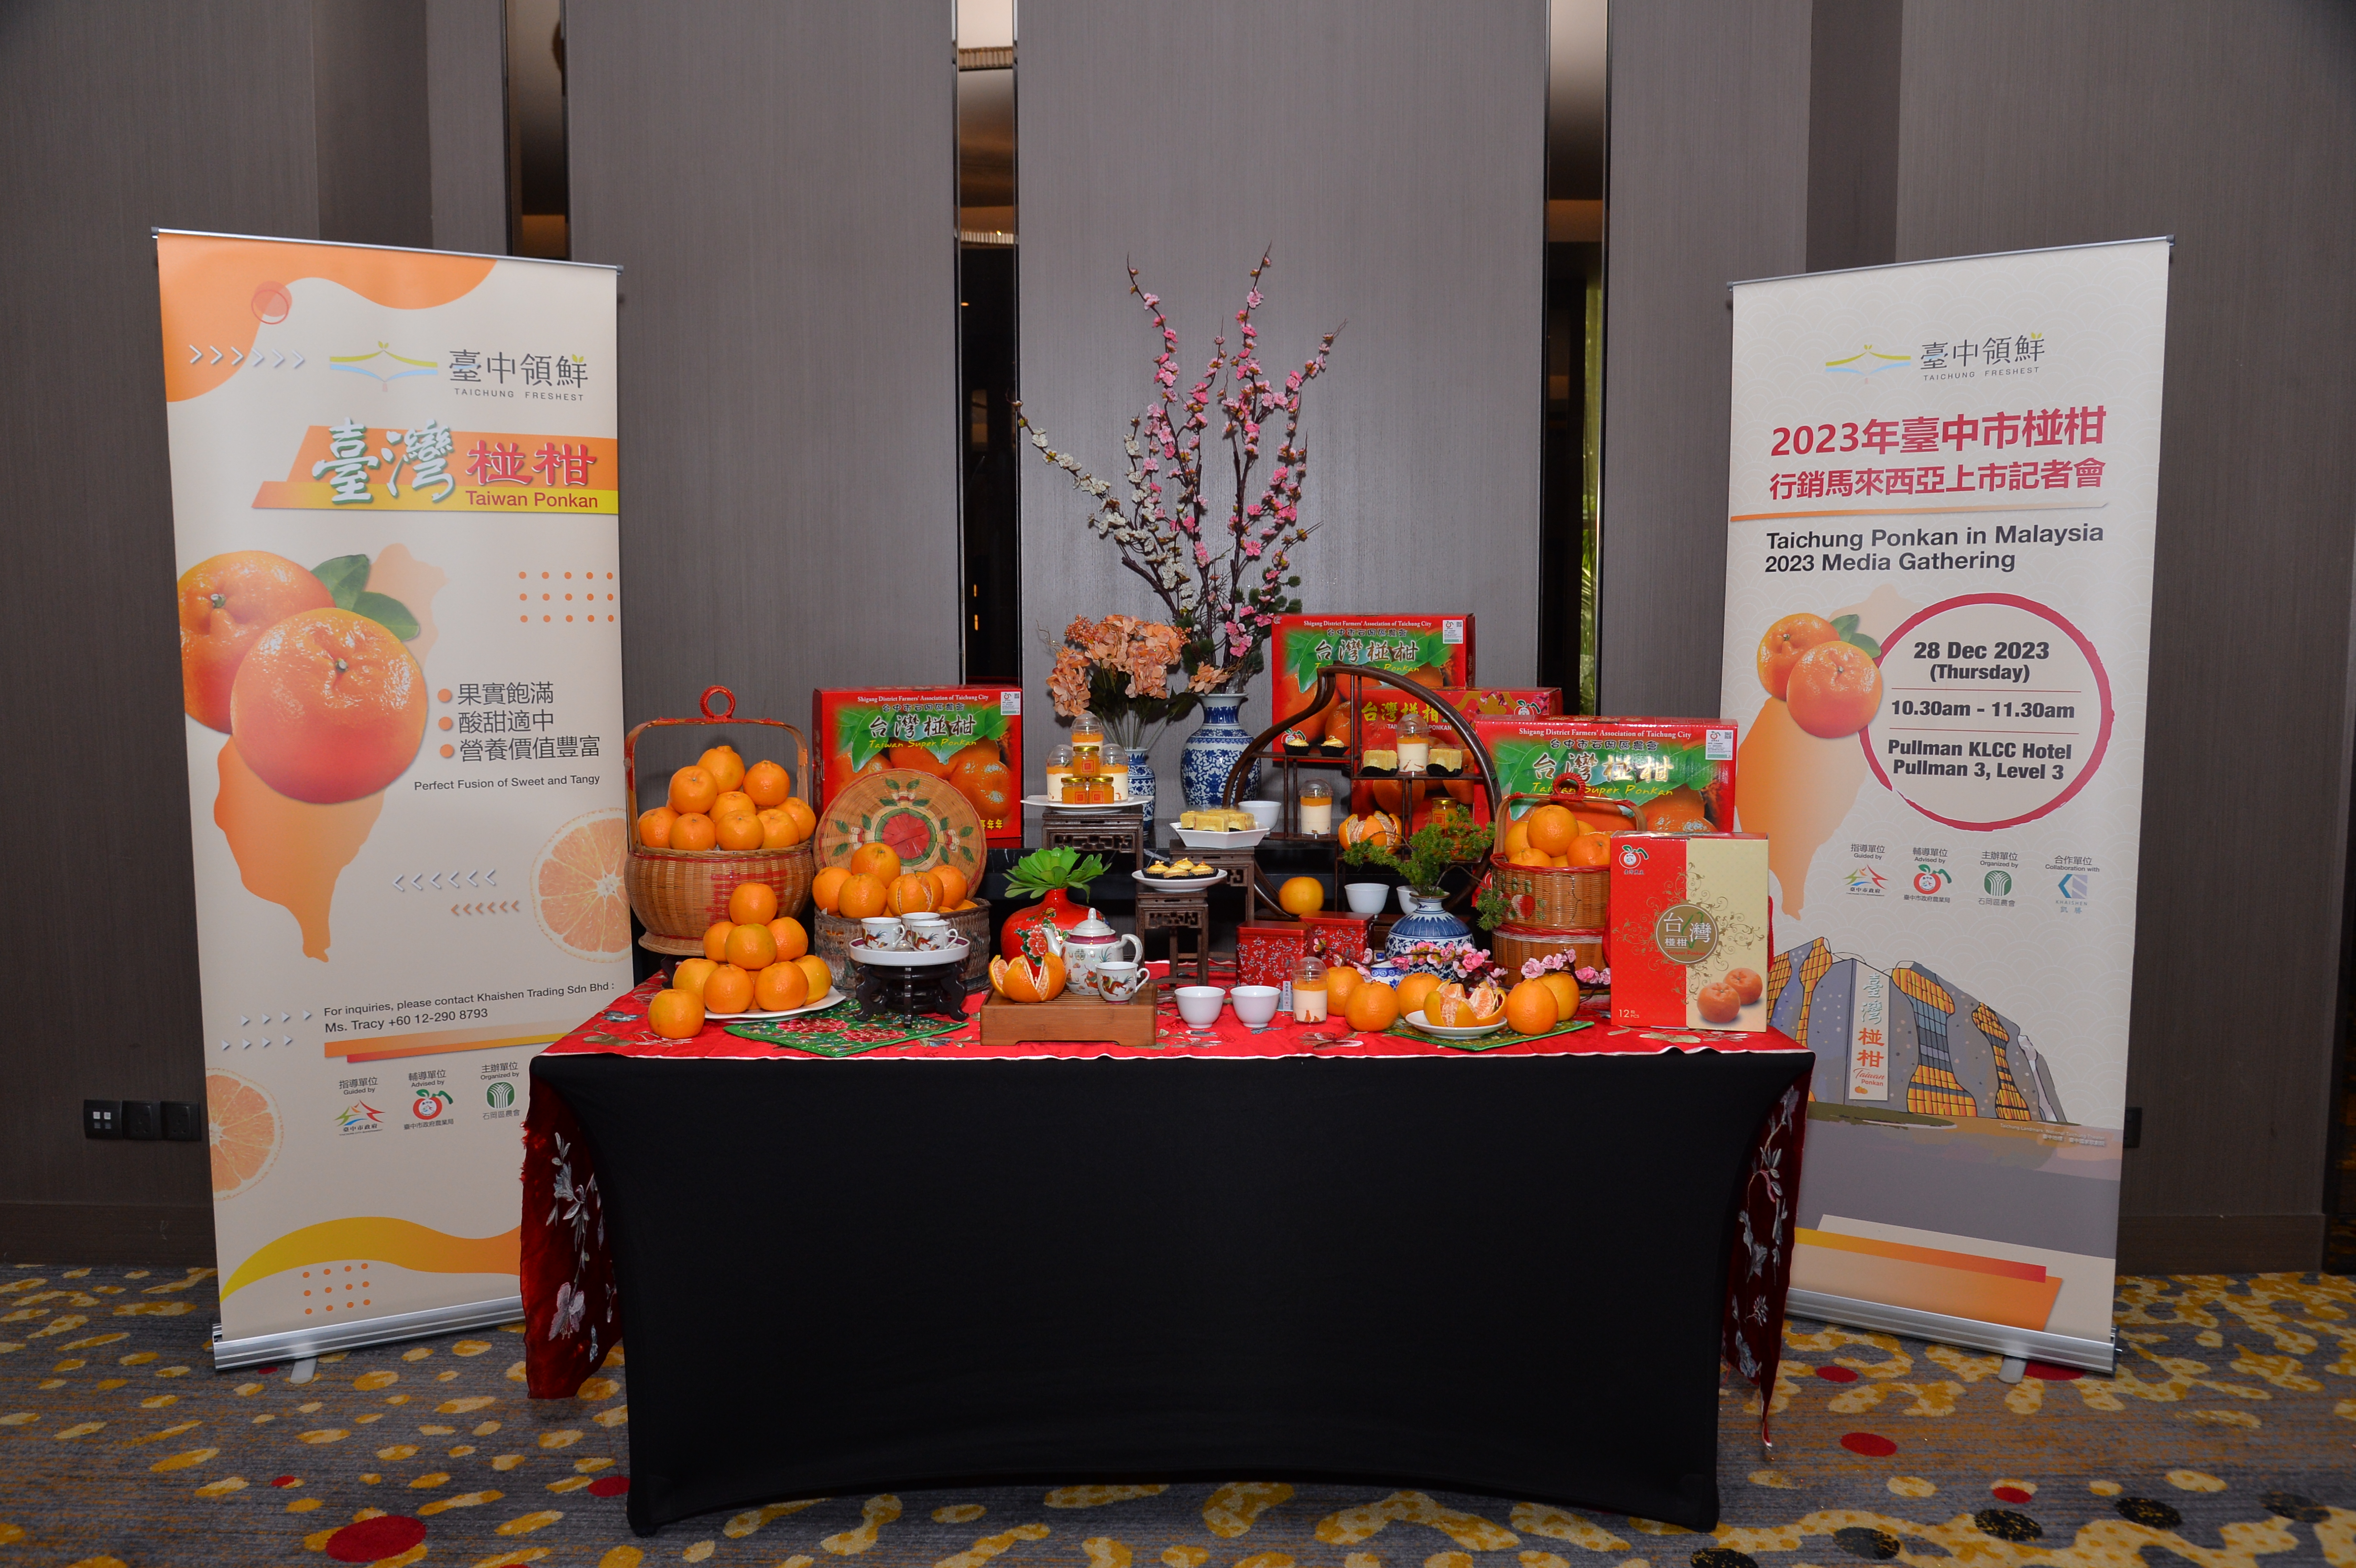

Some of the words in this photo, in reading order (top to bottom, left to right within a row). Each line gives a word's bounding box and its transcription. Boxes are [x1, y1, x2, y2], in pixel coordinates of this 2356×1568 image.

[1920, 334, 2045, 370] 臺中領鮮
[449, 348, 589, 388] 臺中領鮮
[1924, 372, 1975, 381] TAICHUNG
[1985, 367, 2039, 376] FRESHEST
[455, 388, 514, 398] TAICHUNG
[525, 391, 584, 402] FRESHEST
[1770, 405, 2106, 457] 2023年臺中市椪柑
[1770, 457, 2105, 501] 行銷馬來西亞上市記者會
[466, 490, 527, 506] Taiwan
[534, 492, 598, 508] Ponkan
[1767, 532, 1864, 551] Taichung
[1872, 529, 1958, 547] Ponkan
[1966, 528, 1986, 544] in
[1996, 523, 2104, 548] Malaysia
[1766, 555, 1814, 573] 2023
[1822, 554, 1891, 571] Media
[1899, 551, 2016, 572] Gathering
[1315, 639, 1419, 663] 台灣椪柑
[1914, 642, 1940, 659] 28
[1948, 642, 1987, 659] Dec
[1994, 642, 2049, 659] 2023
[1384, 664, 1419, 672] Ponkan
[1930, 664, 2030, 683] (Thursday)
[458, 681, 554, 706] 果實飽滿
[1892, 700, 1971, 716] 10.30am
[1992, 702, 2074, 719] 11.30am
[458, 709, 554, 734] 酸甜適中
[869, 714, 976, 739] 台灣椪柑
[1519, 728, 1544, 736] Shigang
[1646, 730, 1676, 739] Taichung
[1677, 731, 1691, 740] City
[460, 735, 600, 762] 營養價值豐富
[870, 740, 903, 748] Taiwan
[908, 740, 937, 749] Super
[1888, 740, 1962, 756] Pullman
[1969, 742, 2016, 758] KLCC
[2023, 743, 2072, 760] Hotel
[1533, 752, 1674, 783] 台灣椪柑
[1893, 760, 1967, 776] Pullman
[1974, 762, 1990, 780] 3,
[1997, 763, 2045, 779] Level
[2052, 765, 2063, 780] 3
[414, 781, 454, 790] Perfect
[458, 780, 494, 789] Fusion
[498, 779, 508, 787] of
[511, 777, 544, 787] Sweet
[548, 776, 567, 785] and
[570, 774, 600, 785] Tangy
[1532, 783, 1576, 793] Taian
[1625, 785, 1673, 795] Ponkan
[1851, 844, 1885, 853] 指導單位
[1913, 848, 1948, 857] 輔導單位
[1982, 851, 2018, 861] 主辦單位
[2054, 856, 2092, 865] 合作單位
[1904, 895, 1950, 903] 臺中市政府農業局
[1978, 898, 2015, 907] 石岡區農會
[1665, 937, 1687, 947] 椪柑
[324, 1007, 342, 1016] For
[345, 1003, 394, 1015] inquiries,
[397, 999, 431, 1012] please
[435, 994, 474, 1006] contact
[478, 990, 524, 1002] Khaishen
[527, 987, 564, 999] Trading
[567, 985, 587, 994] Sdn
[590, 982, 609, 992] Bhd
[325, 1022, 348, 1033] Ms.
[351, 1018, 384, 1032] Tracy
[389, 1016, 411, 1026] +60
[414, 1011, 456, 1024] 12-290
[459, 1008, 488, 1020] 8793
[1619, 1009, 1629, 1017] 12
[409, 1069, 446, 1081] 輔導單位
[482, 1062, 518, 1073] 主辦單位
[1853, 1068, 1885, 1079] Taiwan
[339, 1077, 378, 1089] 指導單位
[480, 1072, 508, 1080] Organized
[483, 1109, 520, 1120] 石岡區農會
